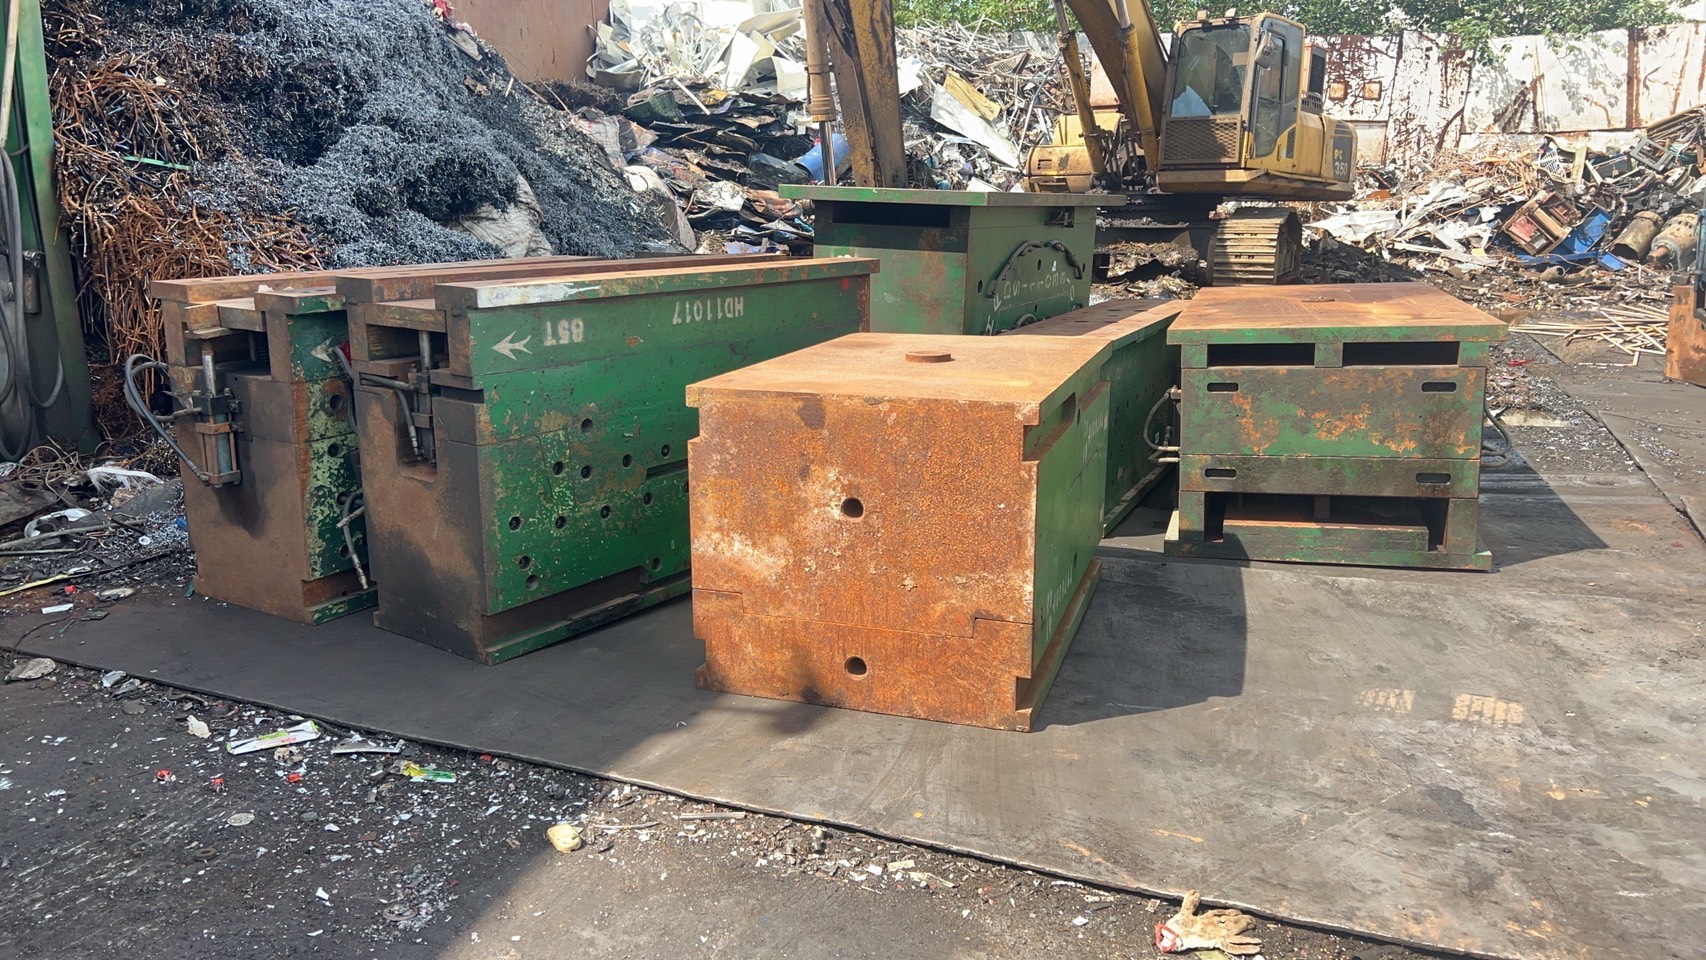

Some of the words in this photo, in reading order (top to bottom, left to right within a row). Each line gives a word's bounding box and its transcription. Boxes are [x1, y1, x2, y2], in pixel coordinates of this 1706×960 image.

[1334, 149, 1343, 160] PC
[1334, 161, 1348, 176] 350
[672, 297, 744, 325] HD11017
[543, 317, 585, 347] 85T
